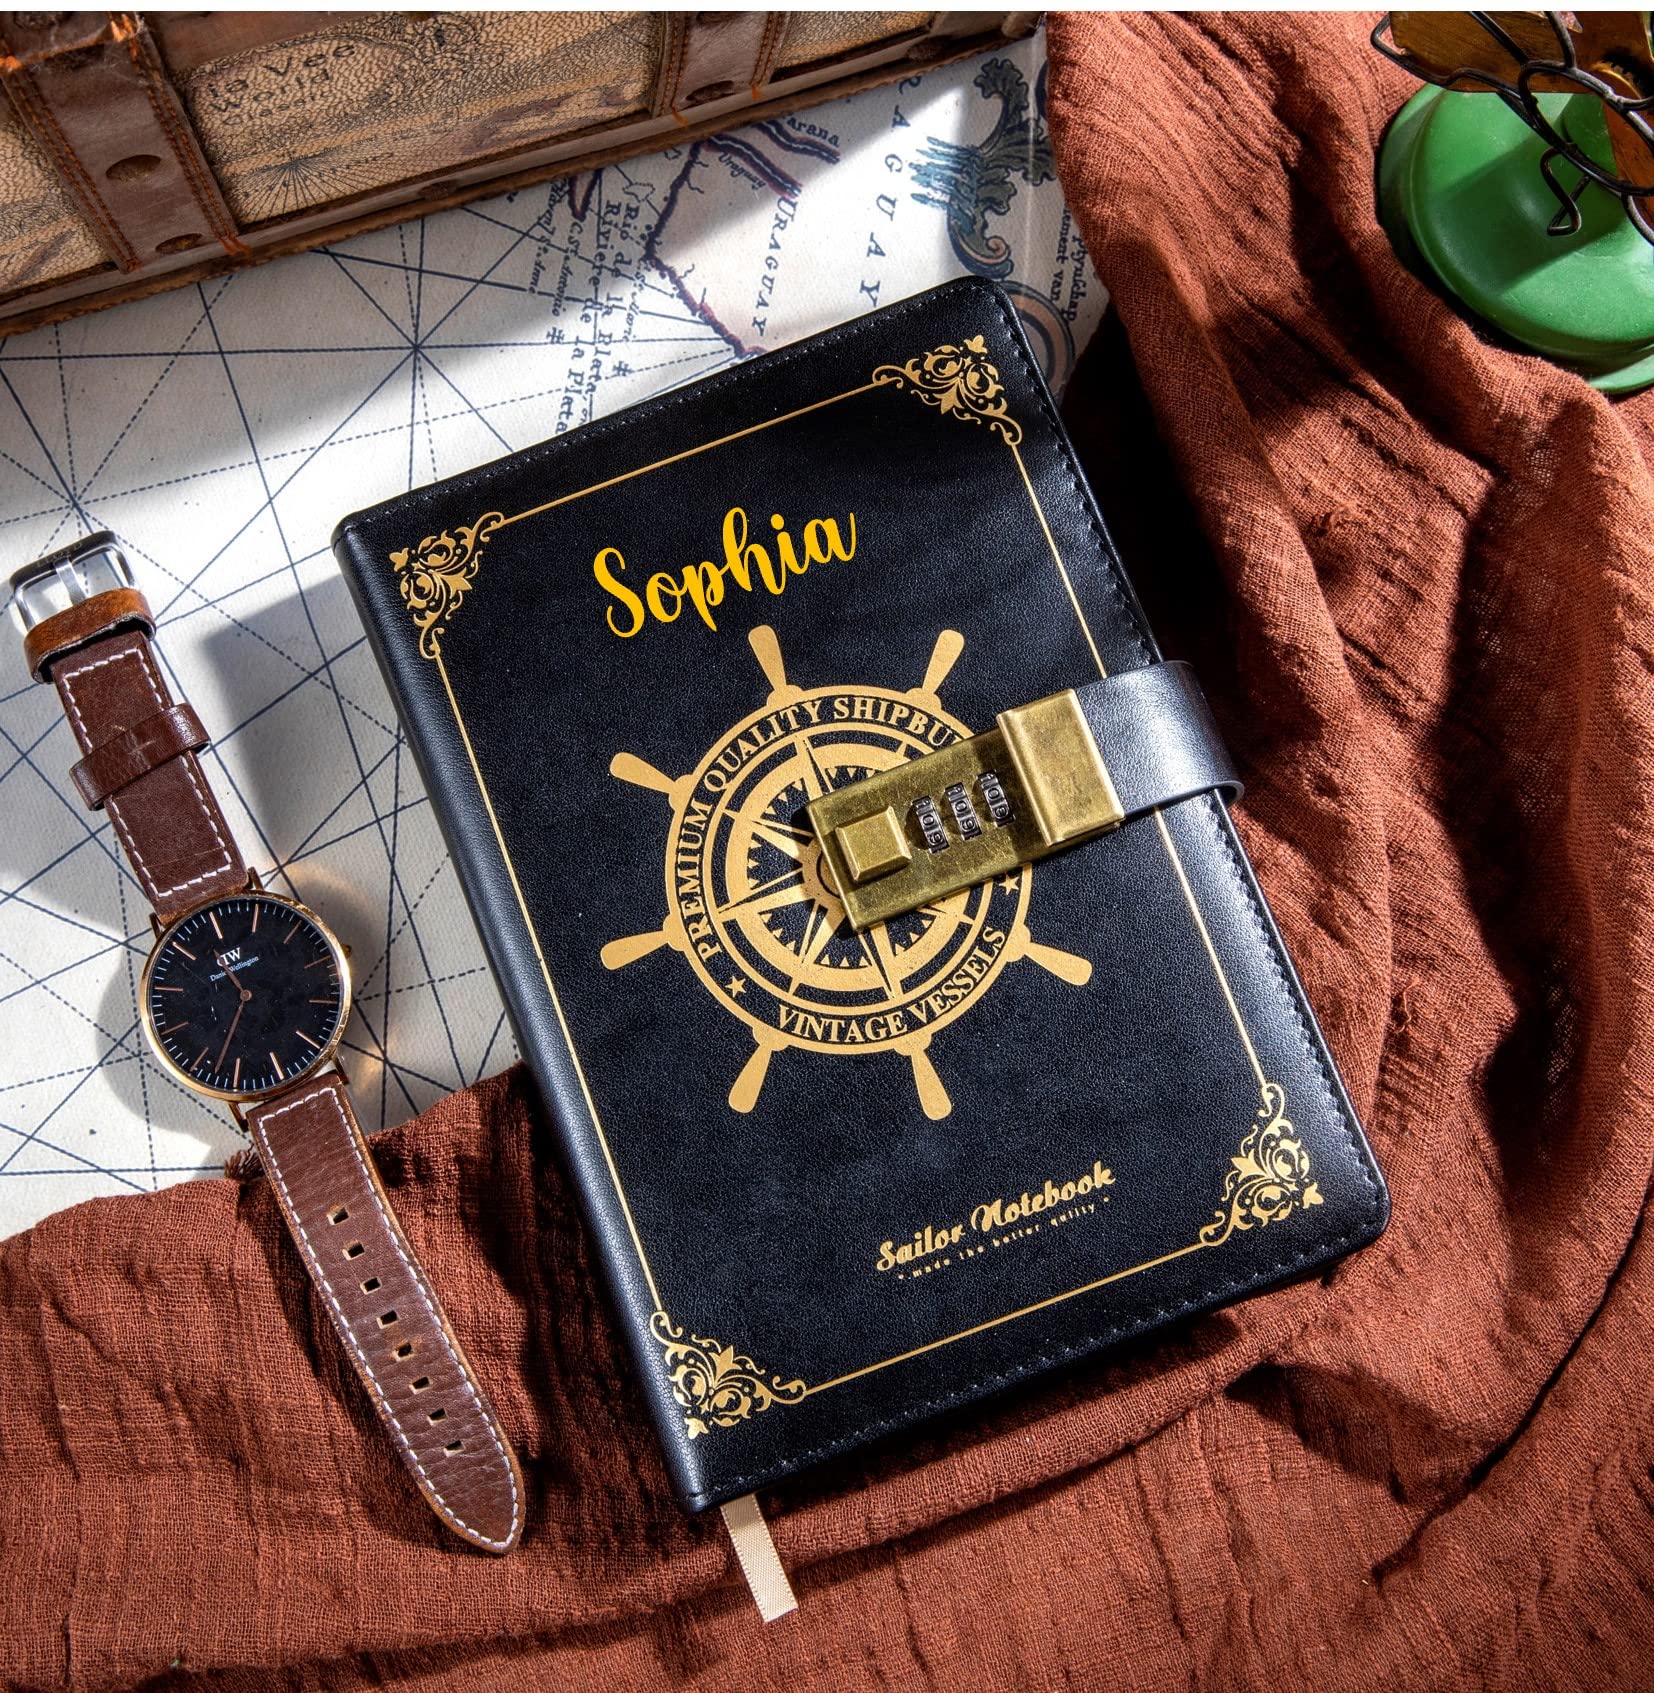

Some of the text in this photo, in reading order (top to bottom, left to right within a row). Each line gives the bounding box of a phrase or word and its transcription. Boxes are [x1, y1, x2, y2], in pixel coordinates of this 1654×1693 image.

[782, 114, 840, 148] arana
[619, 200, 640, 241] Rio
[611, 252, 632, 277] de
[751, 197, 799, 337] URAGUAY
[580, 297, 603, 323] de
[571, 336, 594, 360] la
[555, 368, 586, 434] Plata
[593, 507, 857, 637] Sophia
[677, 797, 722, 962] PREMIUM
[704, 699, 822, 792] QUALITY
[778, 926, 1005, 1042] VINTAGE VESSELS
[876, 1160, 1116, 1271] Sailor Notebook
